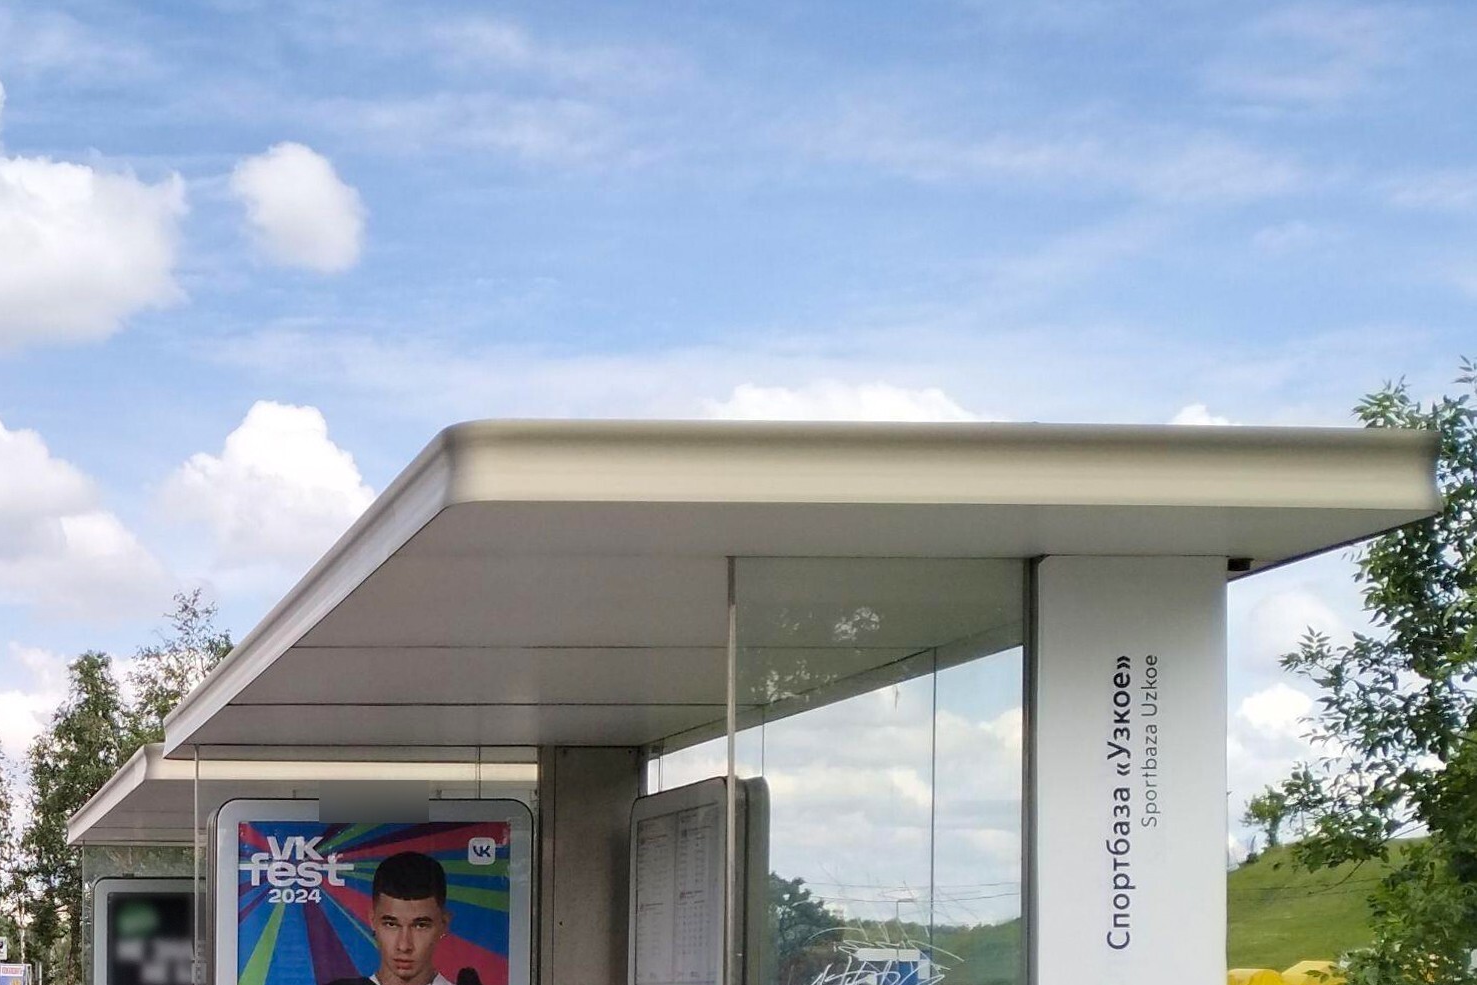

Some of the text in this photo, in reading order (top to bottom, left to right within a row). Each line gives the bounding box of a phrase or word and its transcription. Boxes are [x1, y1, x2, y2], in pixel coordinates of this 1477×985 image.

[1140, 654, 1160, 828] Sportbaza Uzkoe
[1107, 655, 1136, 950] Спортбаза «Узкое»
[266, 835, 324, 861] VK
[472, 845, 491, 858] VK
[239, 852, 355, 888] fest
[268, 888, 322, 904] 2024
